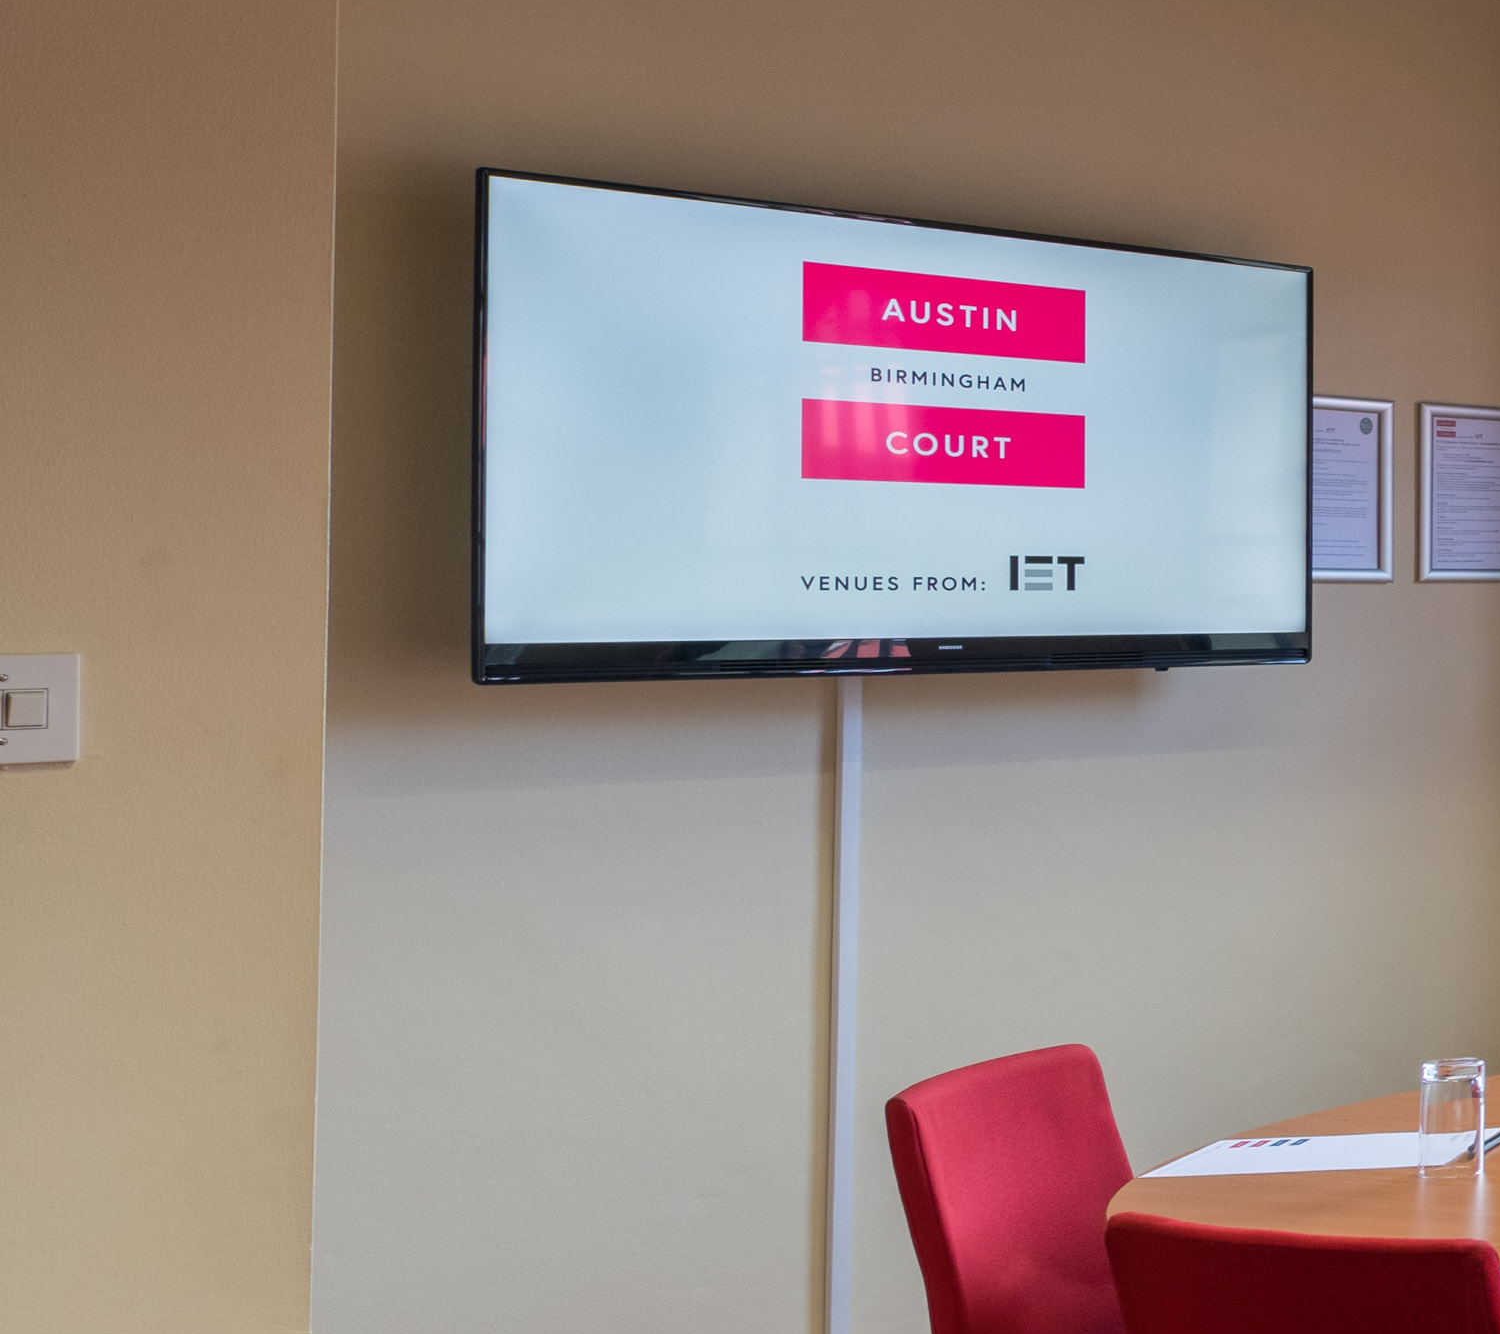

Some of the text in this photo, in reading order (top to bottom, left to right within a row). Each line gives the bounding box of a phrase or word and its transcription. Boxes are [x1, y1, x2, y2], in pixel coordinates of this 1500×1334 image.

[881, 297, 1018, 333] AUSTIN
[870, 367, 1027, 393] BIRMINGHAM
[885, 430, 1012, 460] COURT
[800, 554, 1086, 592] VENUES FROM: IET
